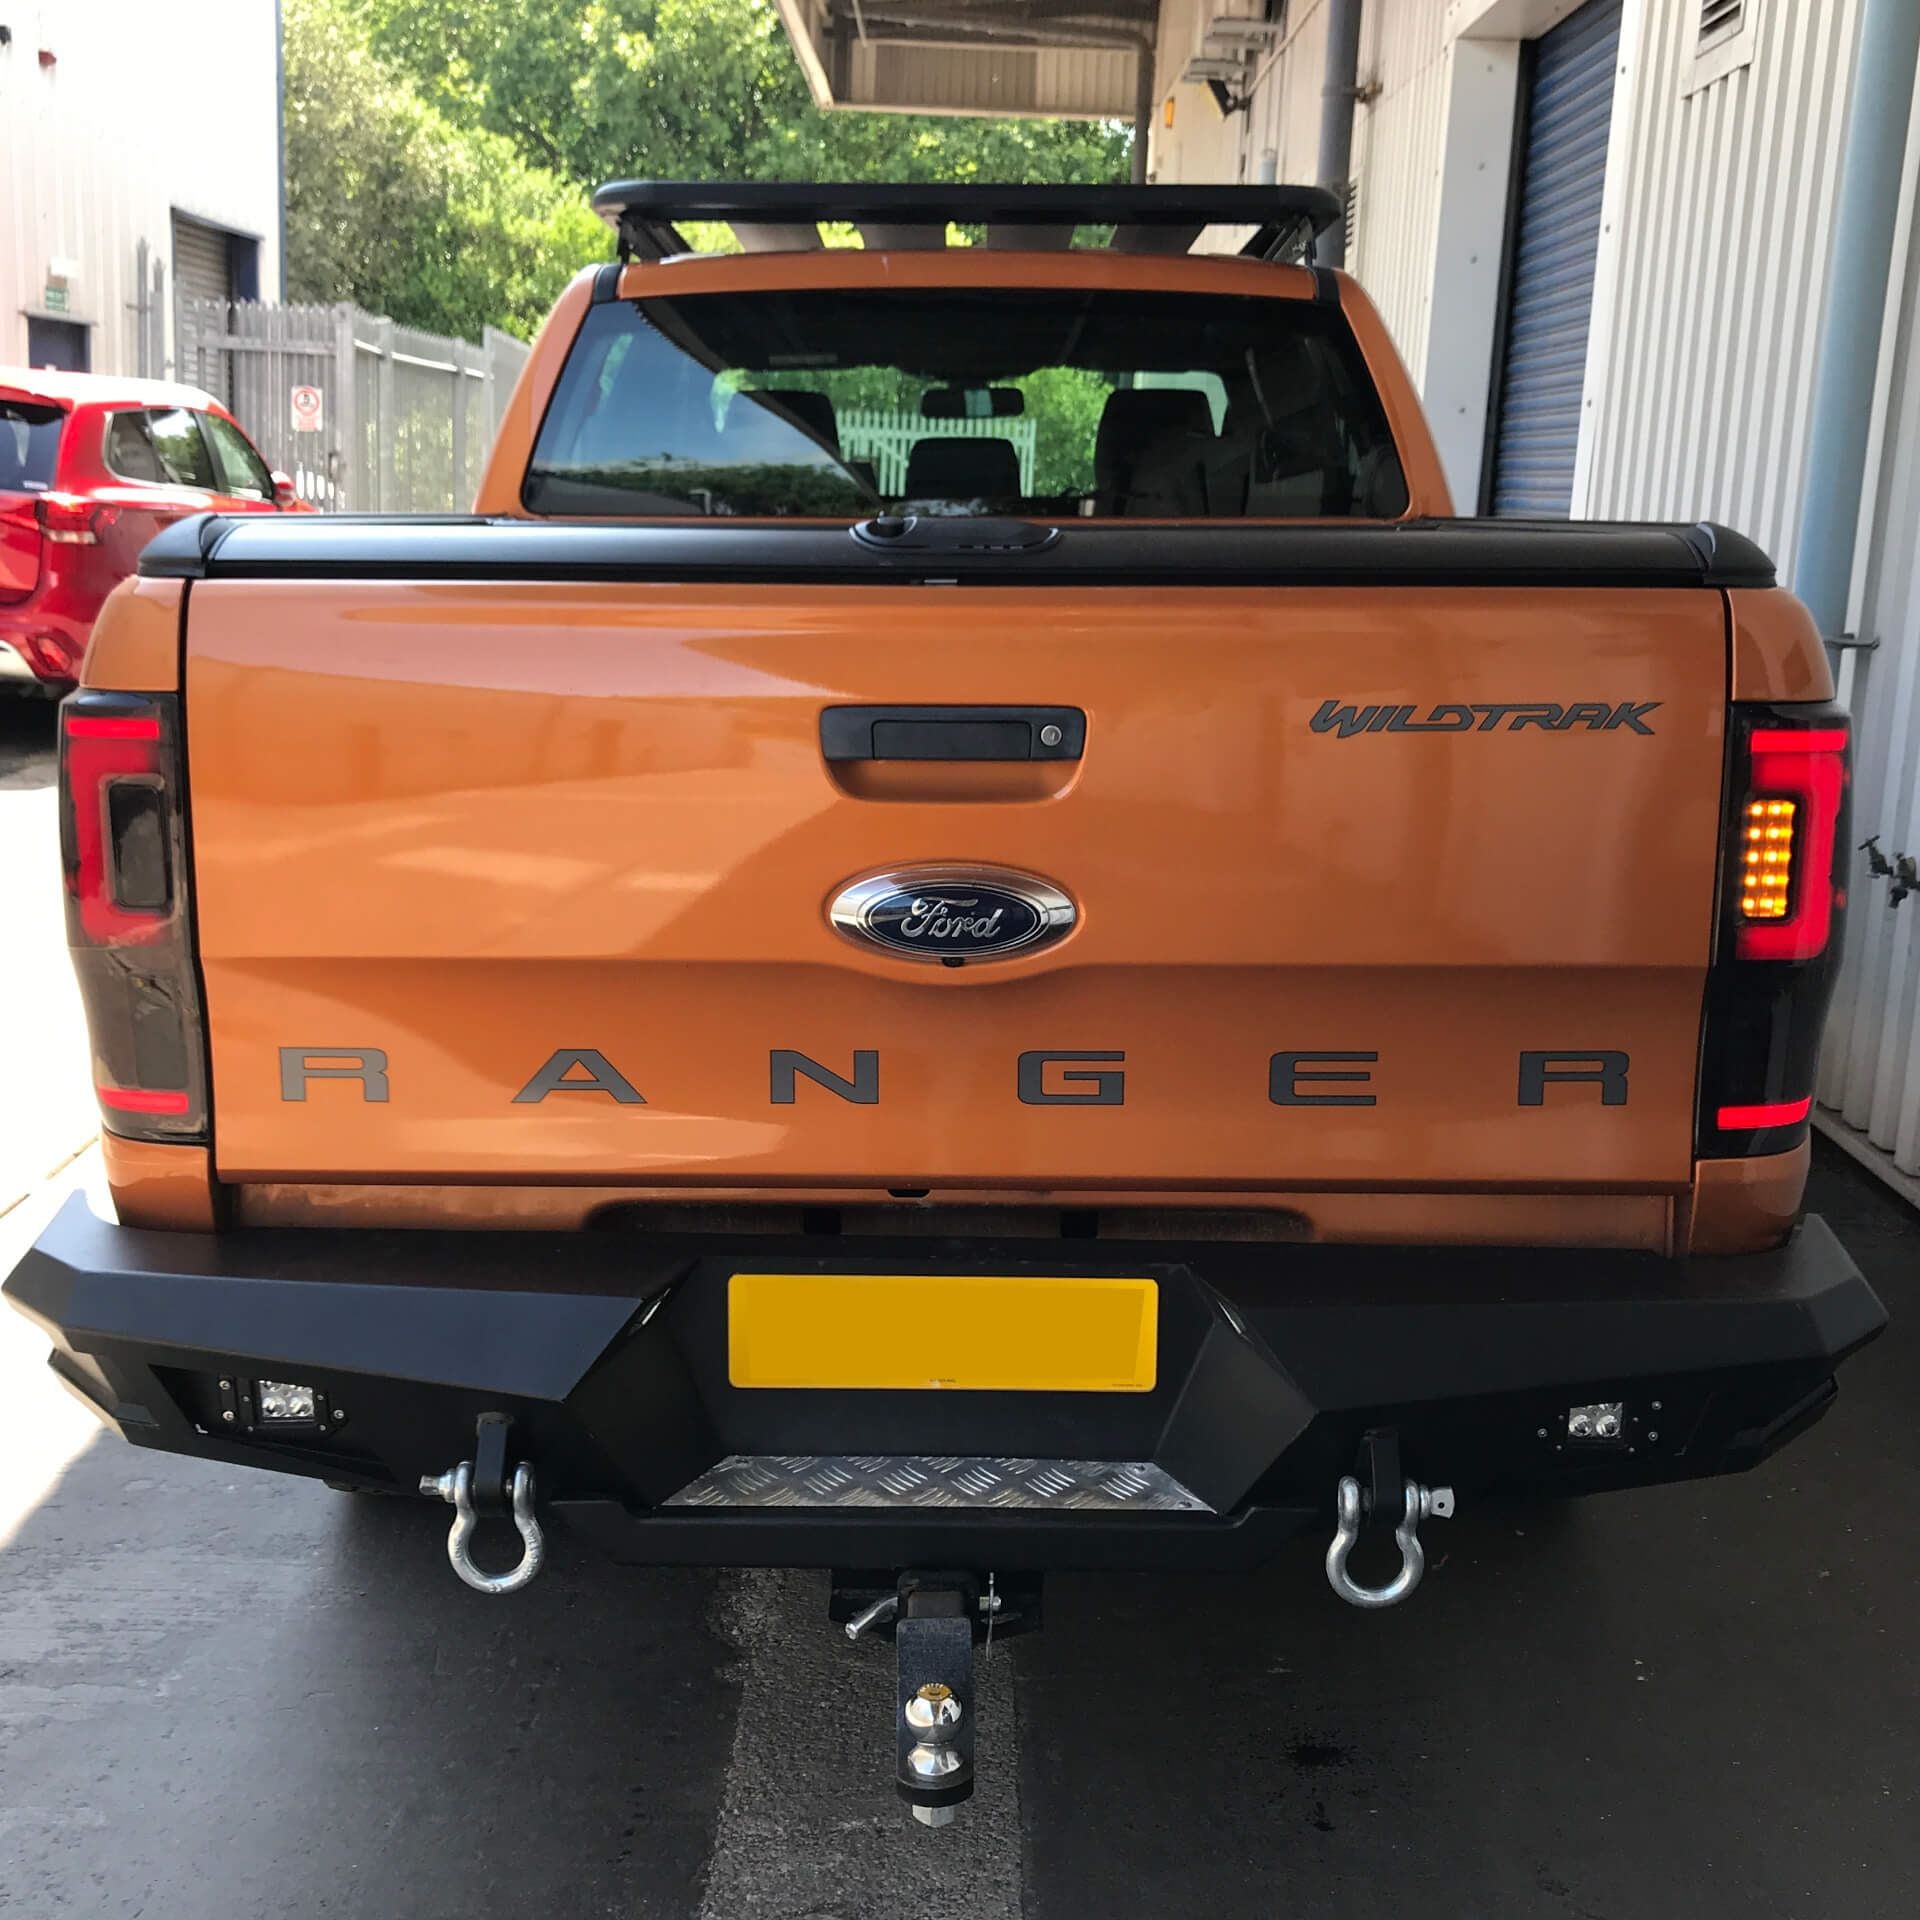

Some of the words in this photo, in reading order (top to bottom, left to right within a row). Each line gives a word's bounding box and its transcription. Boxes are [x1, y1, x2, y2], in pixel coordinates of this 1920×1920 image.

[1309, 700, 1663, 738] WILDTRAK
[900, 896, 1004, 938] Ford
[279, 1046, 1630, 1106] RANGER
